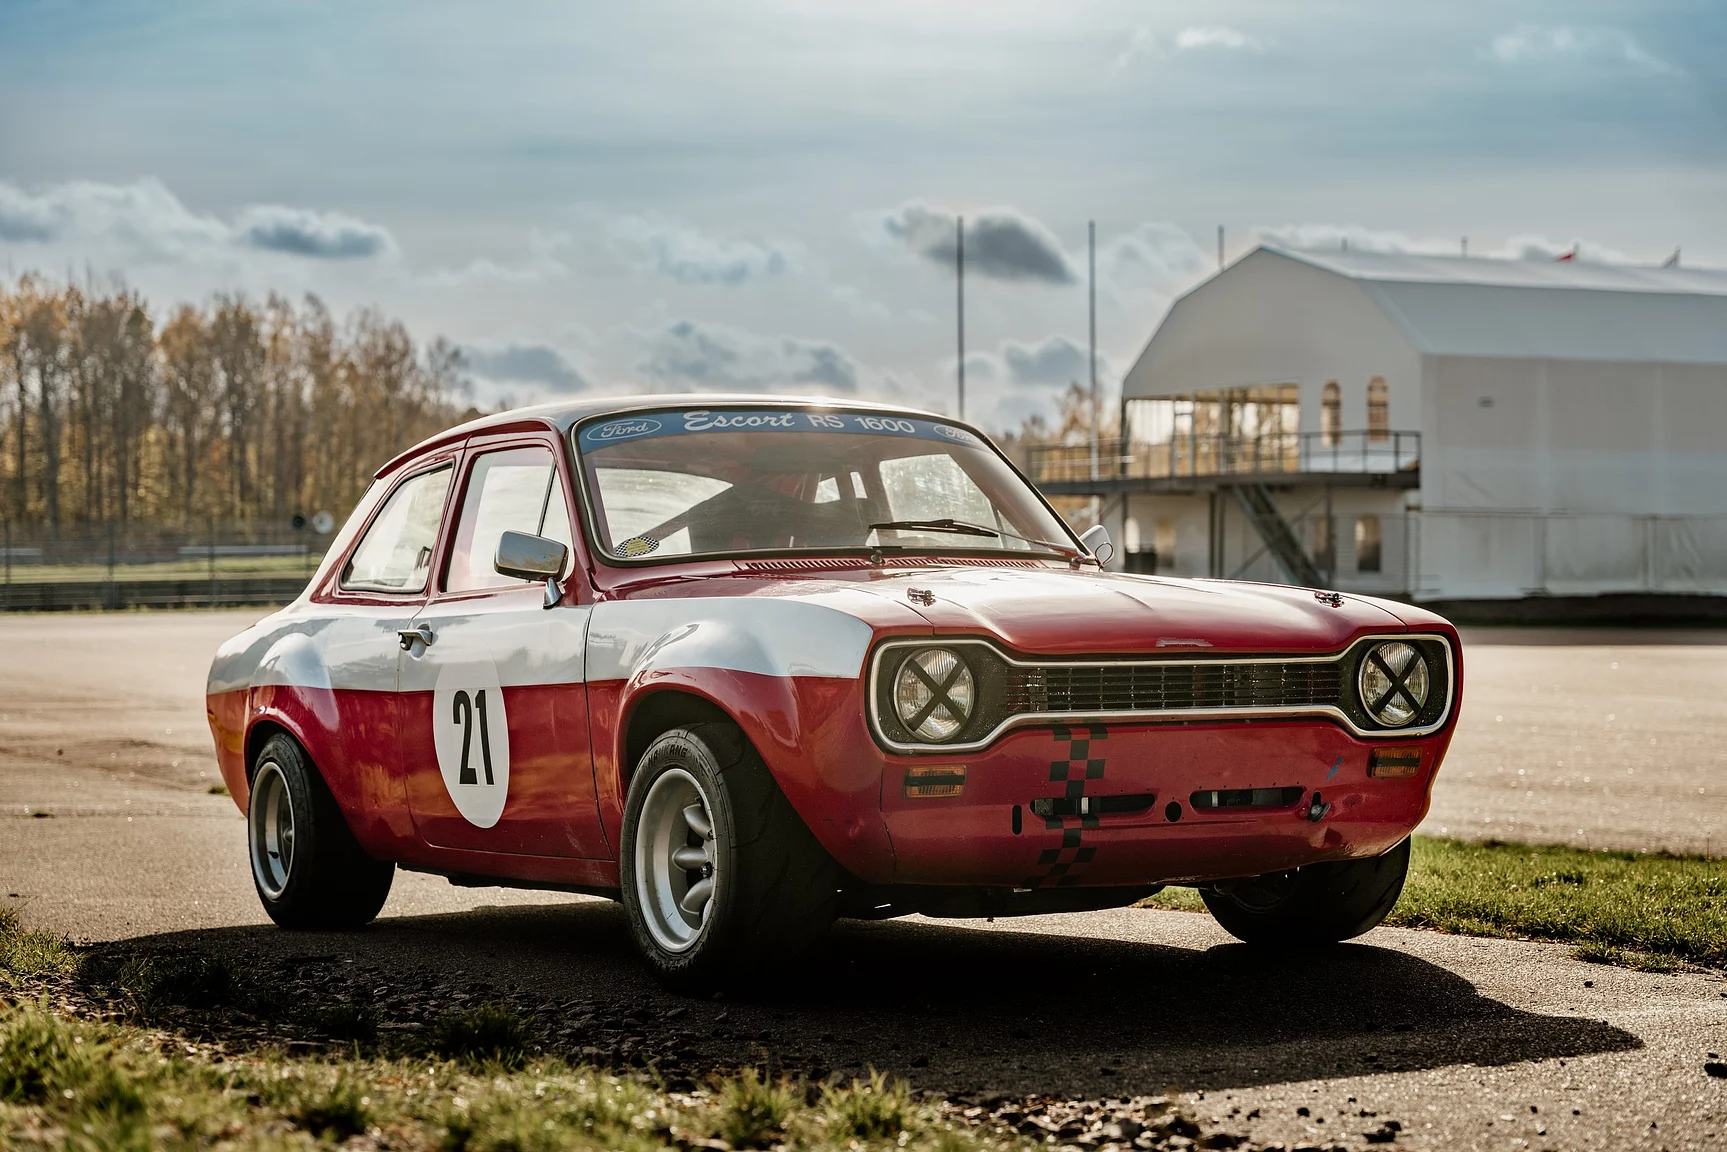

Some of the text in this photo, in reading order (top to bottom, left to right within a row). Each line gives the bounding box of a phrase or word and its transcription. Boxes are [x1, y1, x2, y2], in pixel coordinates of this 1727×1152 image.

[601, 421, 648, 438] Ford
[683, 410, 796, 431] Escort
[806, 414, 845, 428] RS
[854, 416, 915, 434] 1600
[453, 689, 495, 785] 21
